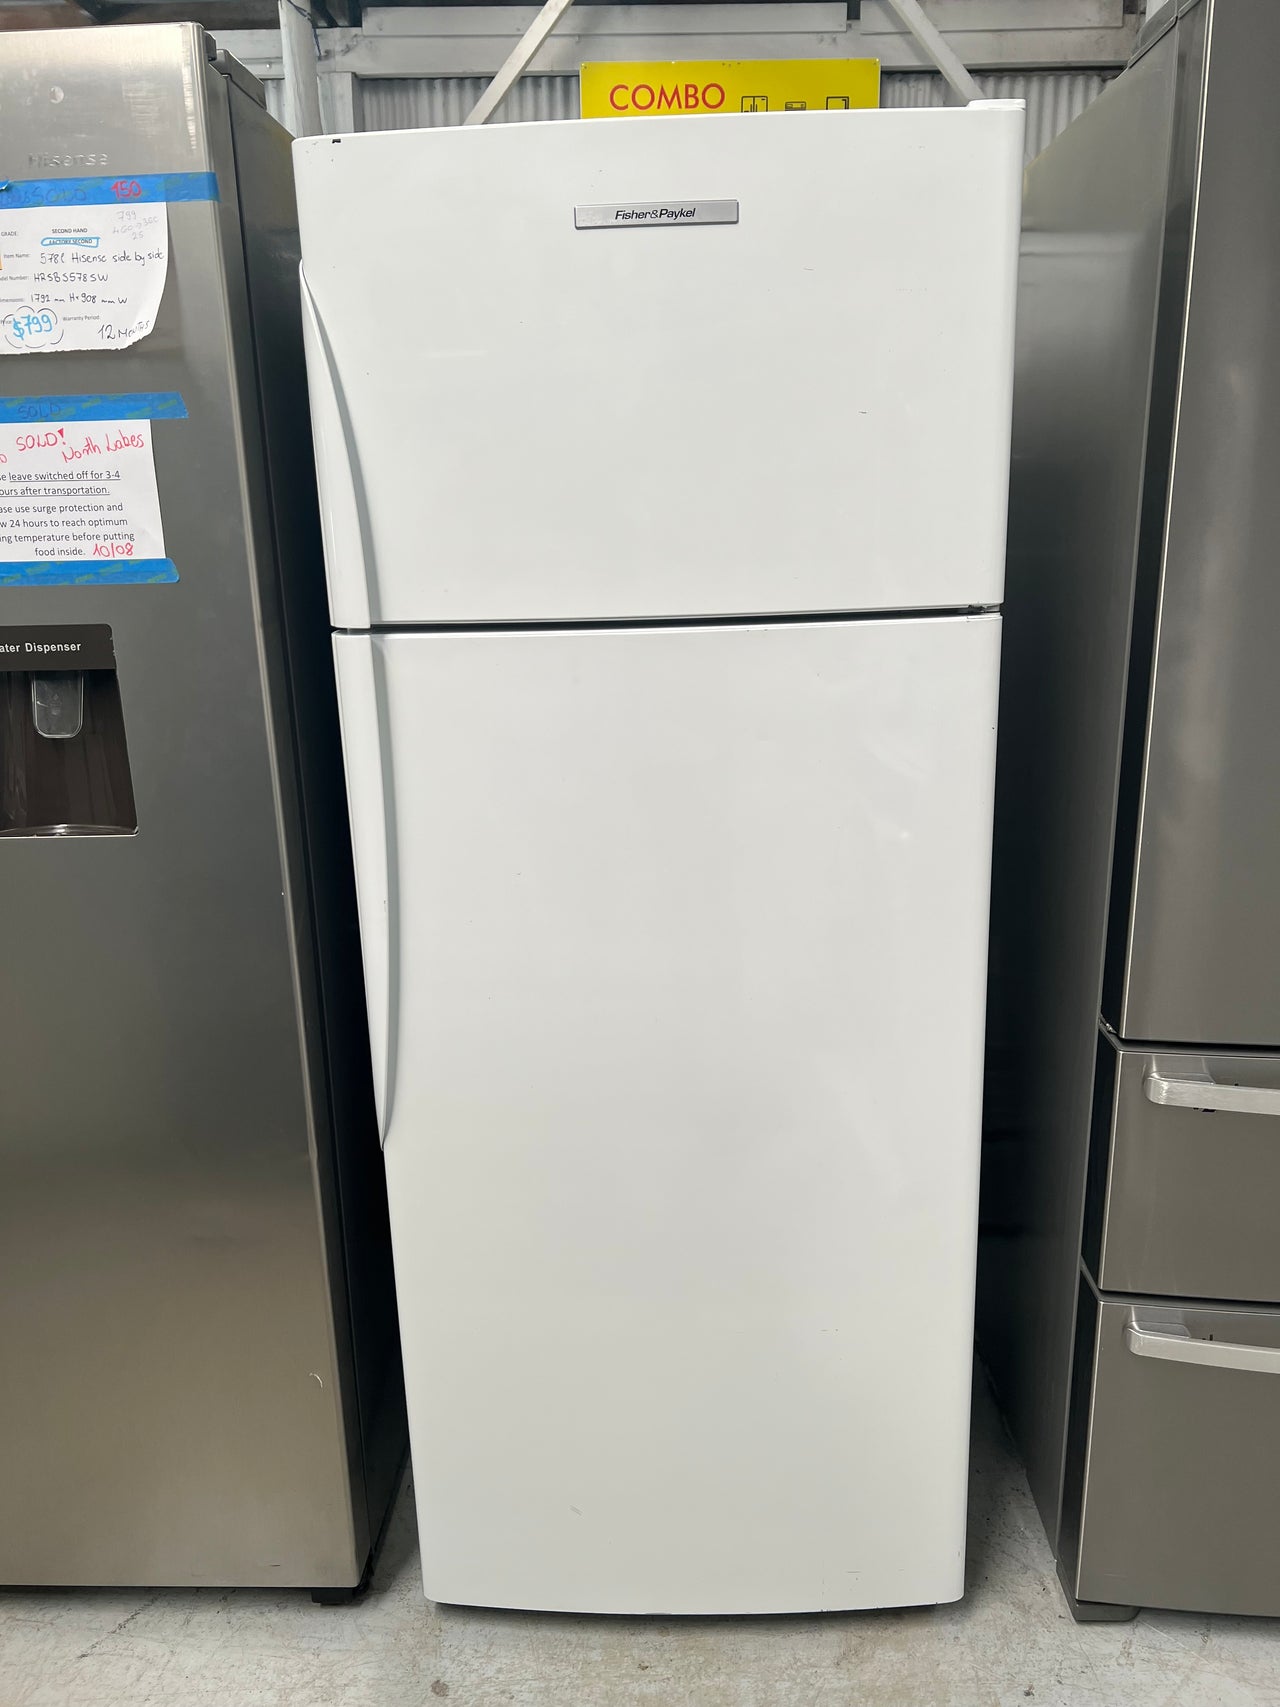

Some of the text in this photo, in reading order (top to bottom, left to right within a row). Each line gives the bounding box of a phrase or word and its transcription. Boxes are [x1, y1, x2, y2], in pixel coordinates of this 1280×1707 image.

[609, 83, 725, 111] COMBO
[111, 179, 143, 201] 150
[615, 207, 697, 221] Fisher&Paykel
[135, 251, 145, 266] by
[13, 313, 53, 341] $799
[98, 324, 116, 340] 12
[9, 472, 32, 481] leave
[34, 471, 74, 480] switched
[76, 470, 88, 480] off
[90, 470, 104, 479] for
[106, 470, 120, 480] 3-4
[20, 486, 42, 495] after
[44, 485, 110, 497] transportation.
[15, 505, 30, 513] use
[32, 505, 57, 515] surge
[59, 503, 105, 514] protection
[107, 502, 123, 512] and
[10, 519, 20, 528] 24
[23, 519, 48, 528] hours
[50, 519, 60, 527] to
[62, 518, 86, 527] reach
[88, 517, 128, 529] optimum
[14, 533, 70, 544] temperature
[72, 532, 101, 541] before
[103, 531, 135, 542] putting
[34, 547, 86, 556] food inside.
[93, 542, 134, 558] 10/08
[25, 642, 81, 654] Dispenser
